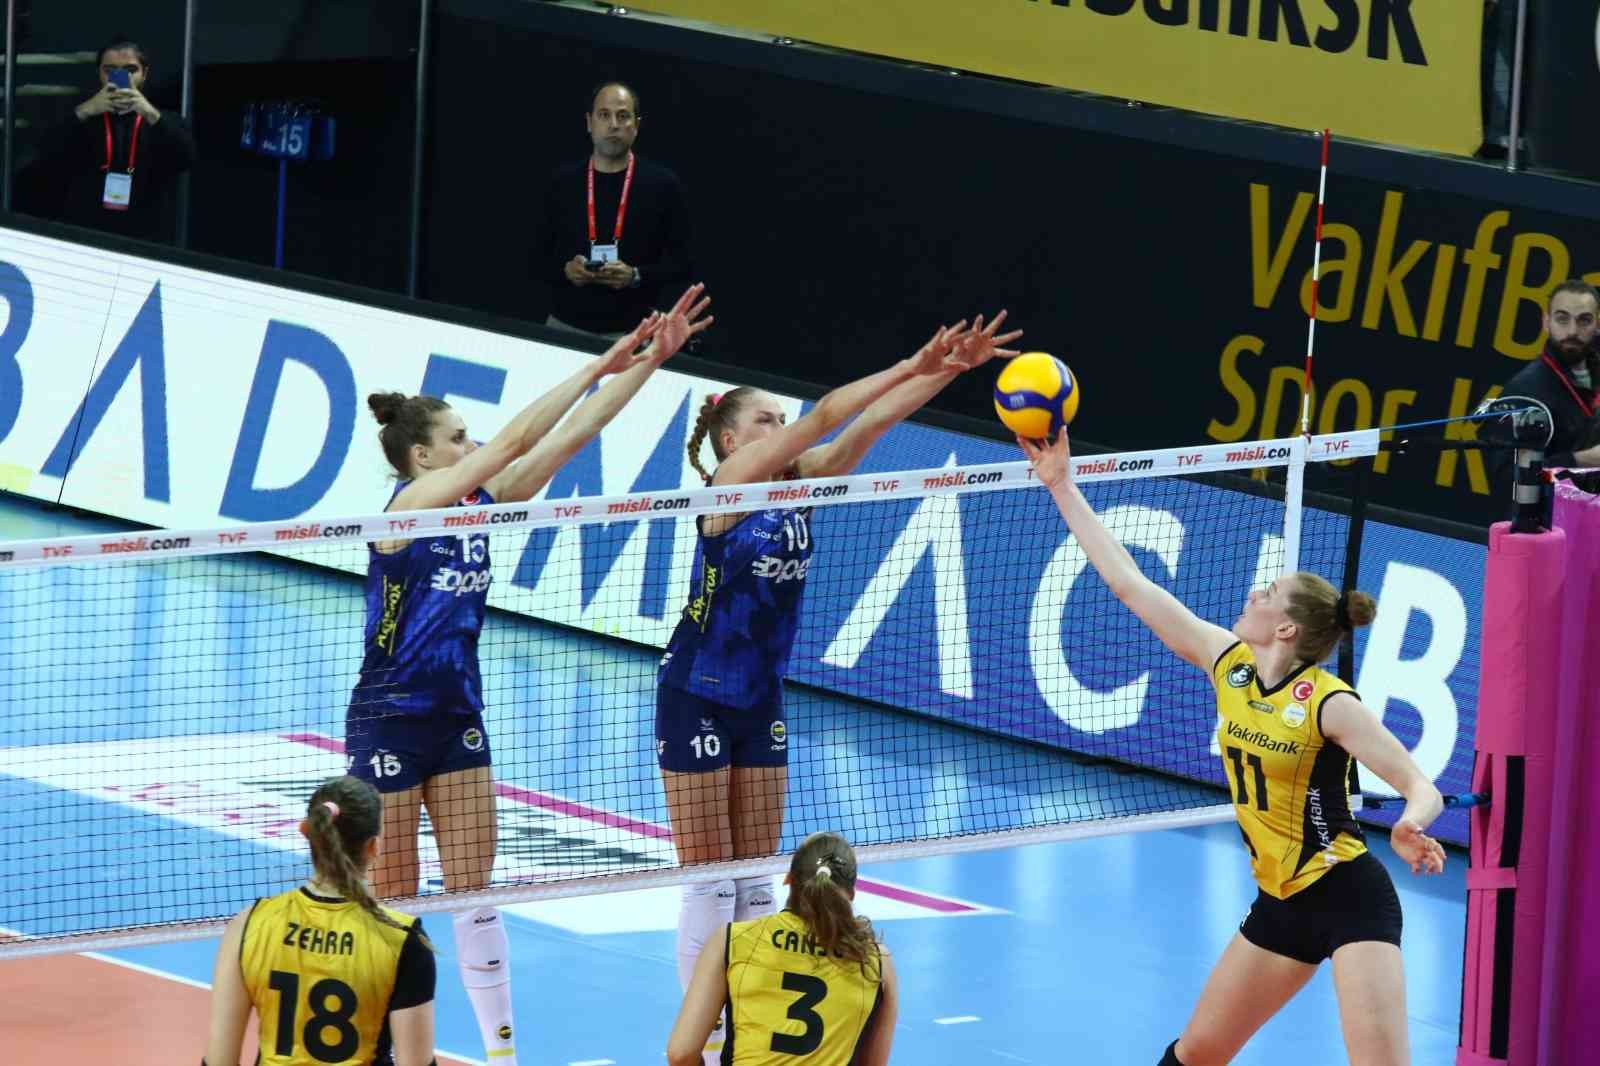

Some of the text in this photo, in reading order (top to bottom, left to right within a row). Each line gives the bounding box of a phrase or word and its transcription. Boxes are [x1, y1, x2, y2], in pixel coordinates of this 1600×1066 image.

[280, 124, 303, 155] 15
[1250, 183, 1600, 361] VakıfB
[1206, 335, 1416, 481] Spor
[42, 546, 73, 558] TVF
[101, 536, 191, 553] misli.com
[217, 532, 249, 545] TVF
[275, 522, 362, 541] misli.com
[388, 518, 417, 532] TVF
[443, 509, 528, 528] misli.com
[553, 505, 583, 519] TVF
[608, 496, 690, 515] misli.com
[715, 493, 743, 506] TVF
[767, 483, 849, 501] misli.com
[873, 480, 900, 493] TVF
[923, 470, 1003, 489] misli.com
[1076, 457, 1154, 476] misli.com
[1177, 454, 1204, 467] TVF
[1325, 440, 1350, 453] TVF
[783, 510, 809, 551] 10
[370, 753, 402, 778] 15
[690, 734, 720, 759] 10
[1226, 746, 1269, 811] 11
[284, 922, 353, 955] ZEHRA
[771, 929, 844, 958] CAN
[269, 970, 360, 1063] 18
[770, 971, 828, 1056] 3
